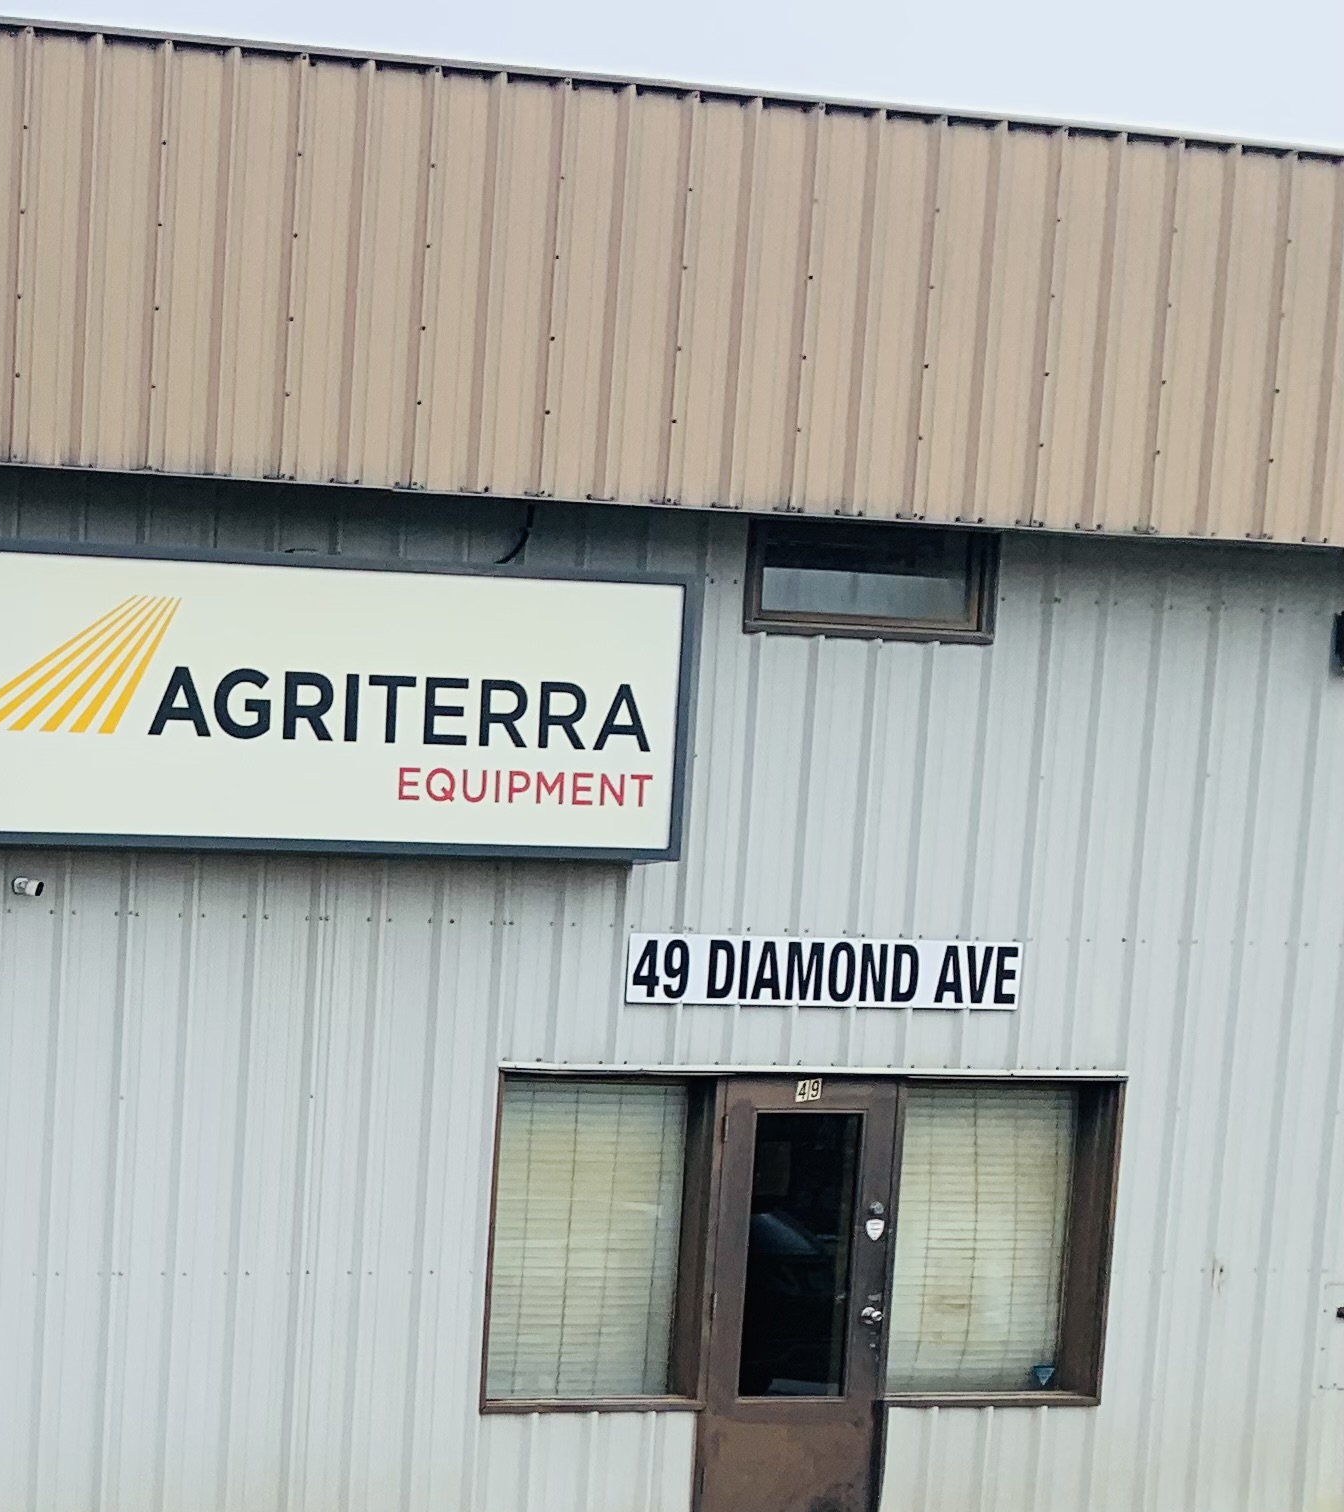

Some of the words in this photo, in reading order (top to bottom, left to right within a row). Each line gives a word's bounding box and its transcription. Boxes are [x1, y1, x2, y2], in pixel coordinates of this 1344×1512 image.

[148, 666, 650, 752] AGRITERRA
[398, 767, 654, 808] EQUIPMENT
[632, 939, 690, 999] 49
[706, 939, 920, 1003] DIAMOND
[933, 945, 1019, 1005] AVE
[798, 1080, 820, 1099] 49
